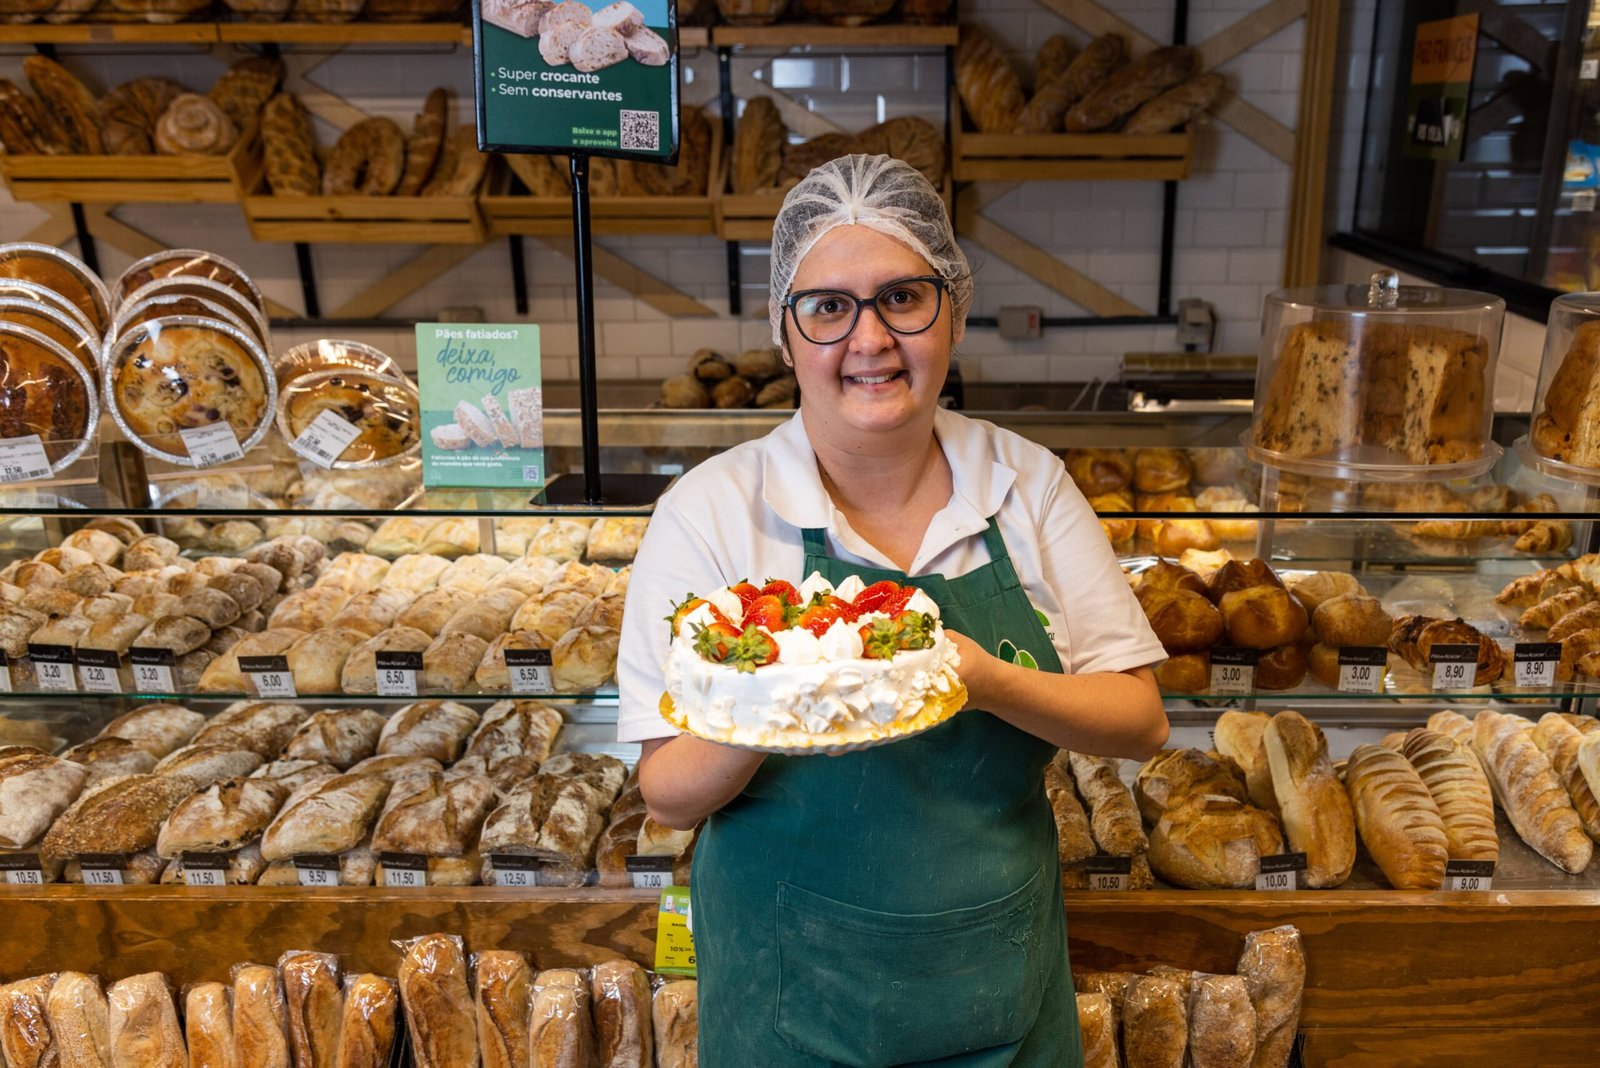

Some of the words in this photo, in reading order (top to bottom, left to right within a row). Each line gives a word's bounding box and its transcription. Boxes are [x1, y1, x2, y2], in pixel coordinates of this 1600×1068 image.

[498, 67, 537, 82] Super
[540, 71, 600, 84] crocante
[499, 84, 529, 96] Sem
[532, 87, 622, 102] conservantes
[572, 127, 594, 135] Baixe
[435, 329, 463, 339] Pães
[466, 328, 518, 340] fatiados?
[437, 336, 494, 367] deixa
[446, 360, 521, 396] comigo
[520, 667, 538, 681] 6,50
[1222, 667, 1241, 681] 3,00
[1351, 666, 1370, 681] 3,00
[1445, 665, 1464, 679] 8,90
[1526, 661, 1544, 675] 8,90
[262, 674, 282, 687] 6,00
[386, 670, 404, 684] 6,50
[15, 872, 38, 884] 10,50
[91, 872, 114, 884] 11,50
[191, 872, 214, 884] 11,50
[309, 871, 327, 883] 9,50
[392, 872, 414, 884] 11,50
[504, 872, 526, 885] 12,50
[643, 874, 661, 886] 7,00
[1098, 876, 1120, 889] 10,50
[1265, 874, 1287, 888] 10,00
[1460, 878, 1479, 889] 9,00
